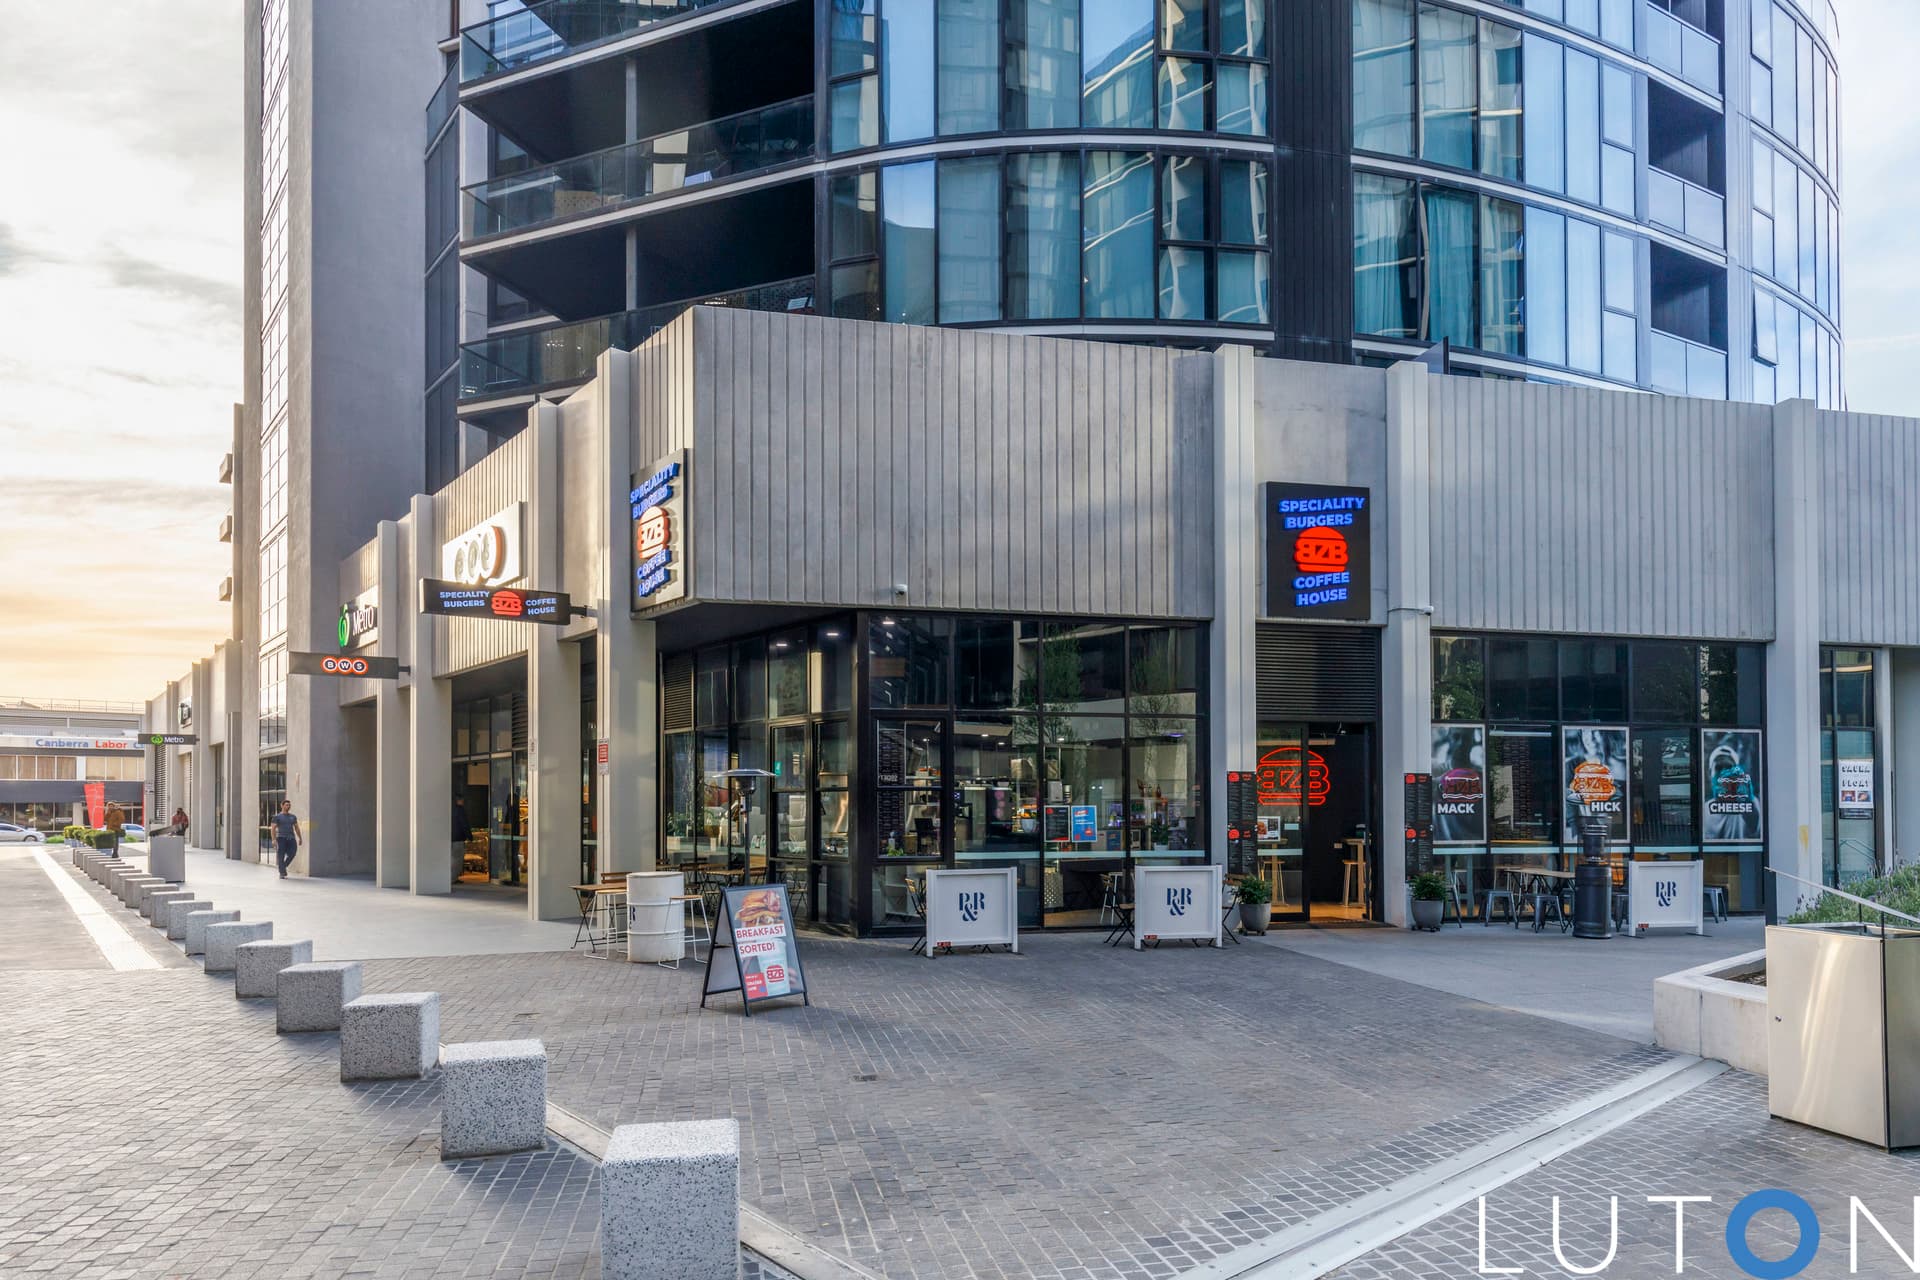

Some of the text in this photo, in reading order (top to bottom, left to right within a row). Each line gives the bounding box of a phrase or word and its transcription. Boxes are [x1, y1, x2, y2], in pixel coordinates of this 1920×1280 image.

[630, 463, 679, 503] SPECIALITY
[632, 484, 673, 520] BURGERS
[1279, 497, 1365, 512] SPECIALITY
[1284, 513, 1353, 529] BURGERS
[637, 549, 672, 579] COFFEE
[639, 567, 670, 597] HOUSE
[1293, 571, 1351, 589] COFFEE
[439, 591, 490, 599] SPECIALITY
[1296, 588, 1347, 606] HOUSE
[443, 600, 485, 608] BURGERS
[525, 598, 557, 606] COFFEE
[527, 606, 556, 615] HOUSE
[353, 606, 374, 636] Metro
[35, 738, 89, 748] Canberra
[95, 740, 128, 749] Labor
[164, 736, 184, 744] Metro
[1437, 803, 1475, 814] MACK
[1710, 802, 1753, 813] CHEESE
[736, 925, 784, 938] BREAKFAST
[740, 942, 775, 954] SORTED!
